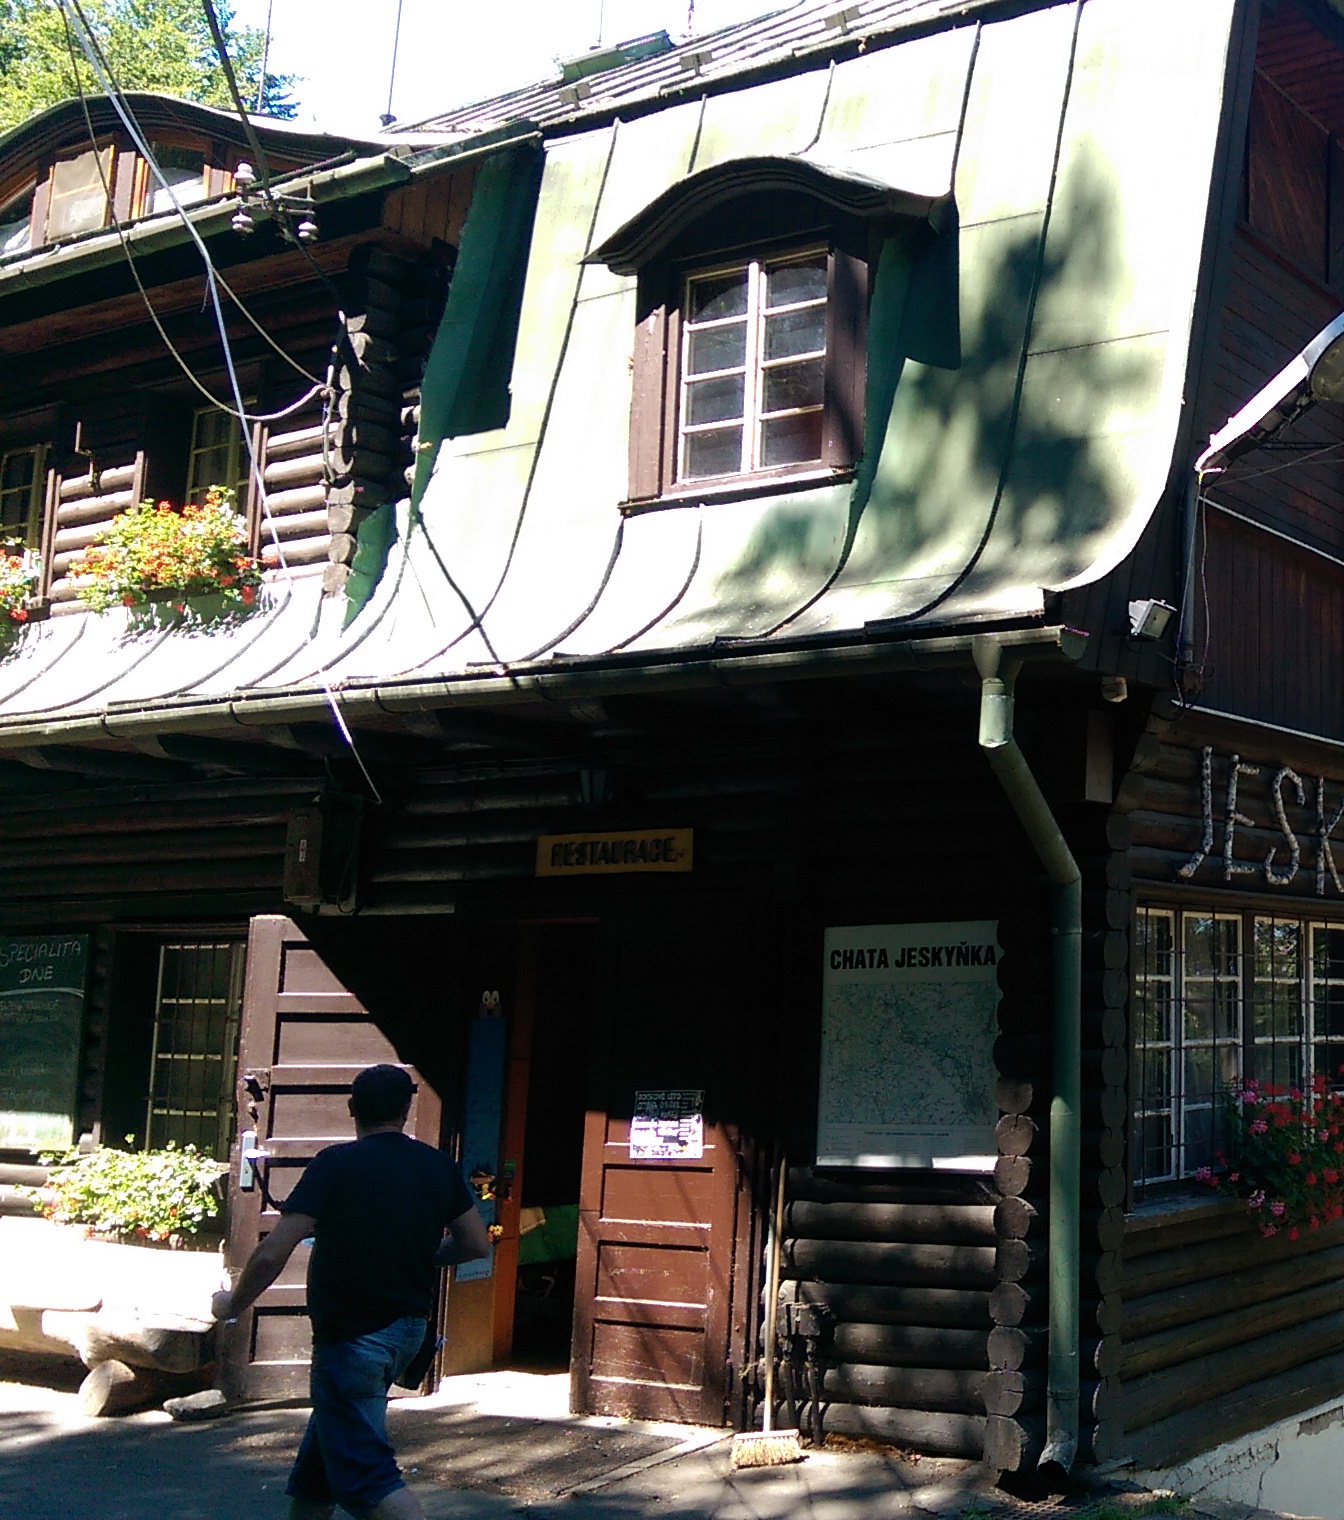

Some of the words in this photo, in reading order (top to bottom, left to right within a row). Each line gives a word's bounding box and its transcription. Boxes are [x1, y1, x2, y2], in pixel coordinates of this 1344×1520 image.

[551, 837, 677, 867] RESTAURACE
[830, 949, 889, 970] CHATA
[895, 941, 997, 969] JESKYŇKA
[19, 966, 54, 984] DNE
